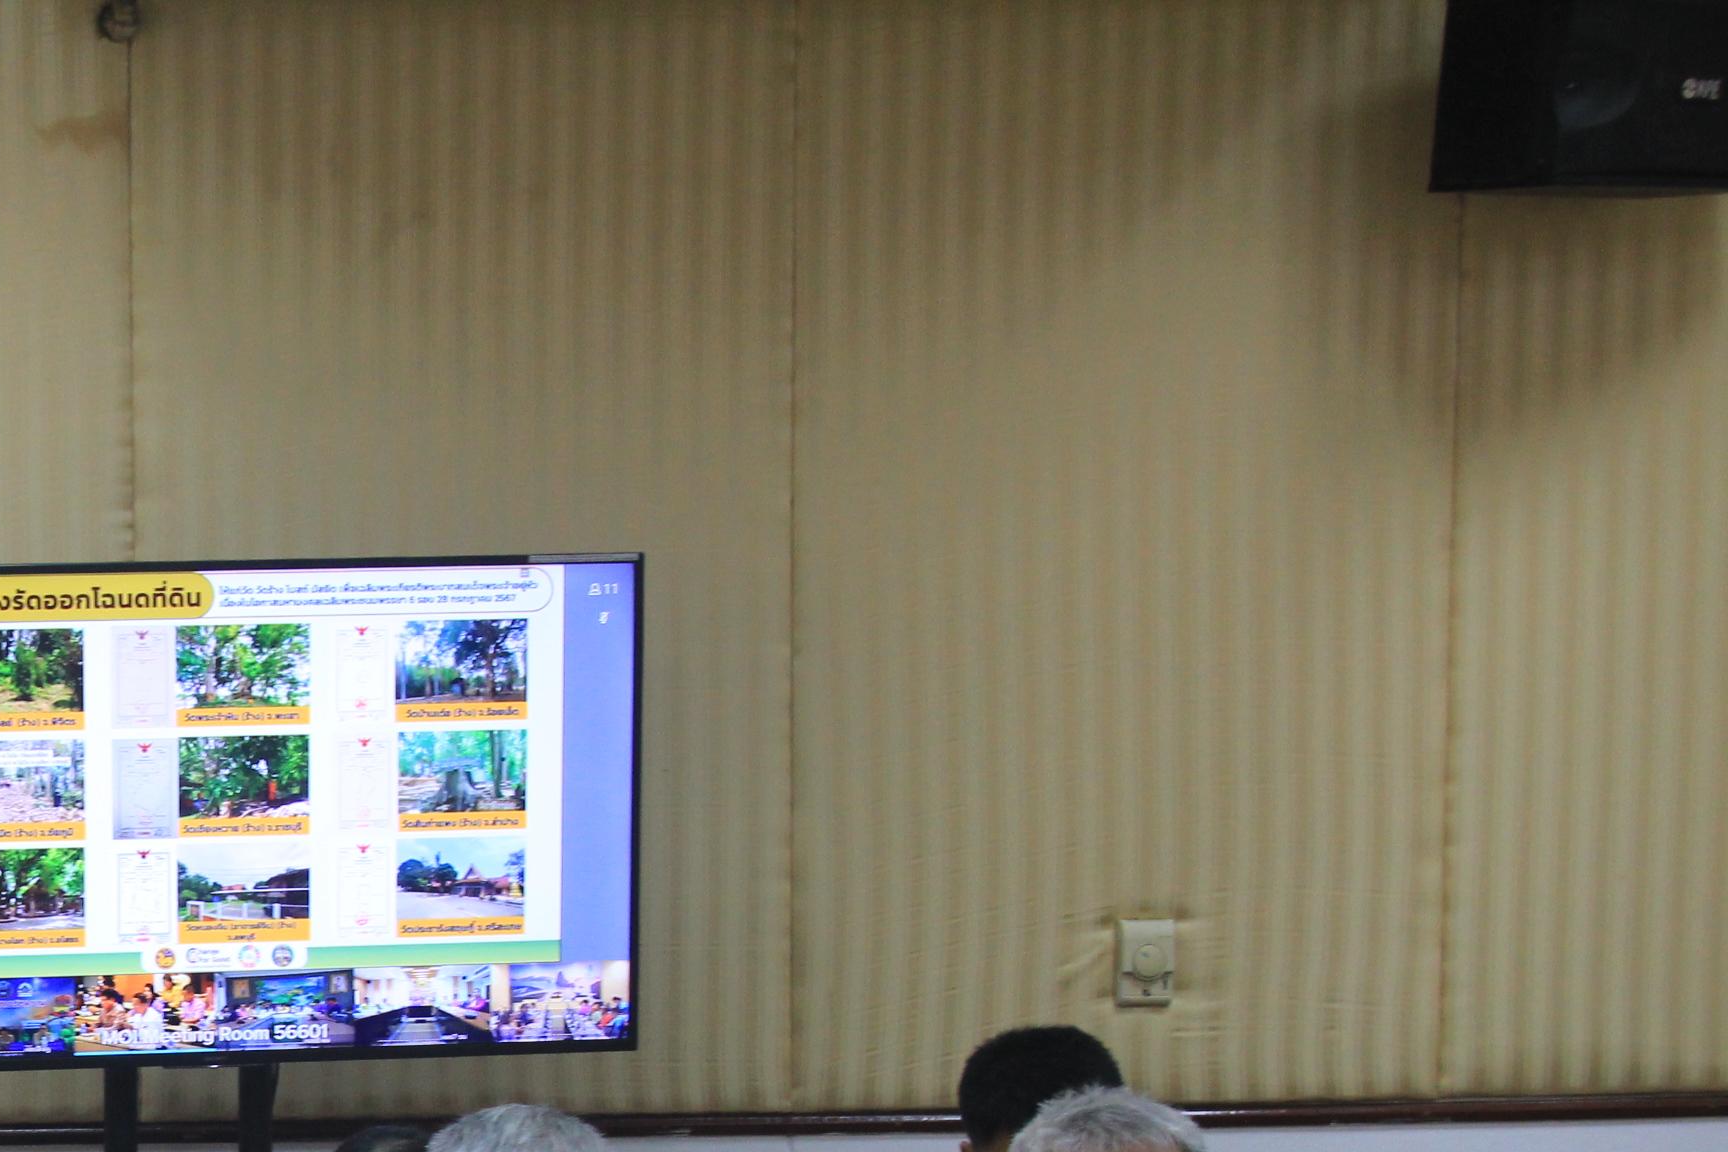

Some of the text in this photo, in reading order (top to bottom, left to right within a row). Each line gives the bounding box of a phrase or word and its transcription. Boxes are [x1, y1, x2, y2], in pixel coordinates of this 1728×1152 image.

[603, 583, 618, 594] 11
[144, 1028, 215, 1046] Meeting
[218, 1026, 271, 1042] Room
[273, 1023, 329, 1041] 56601
